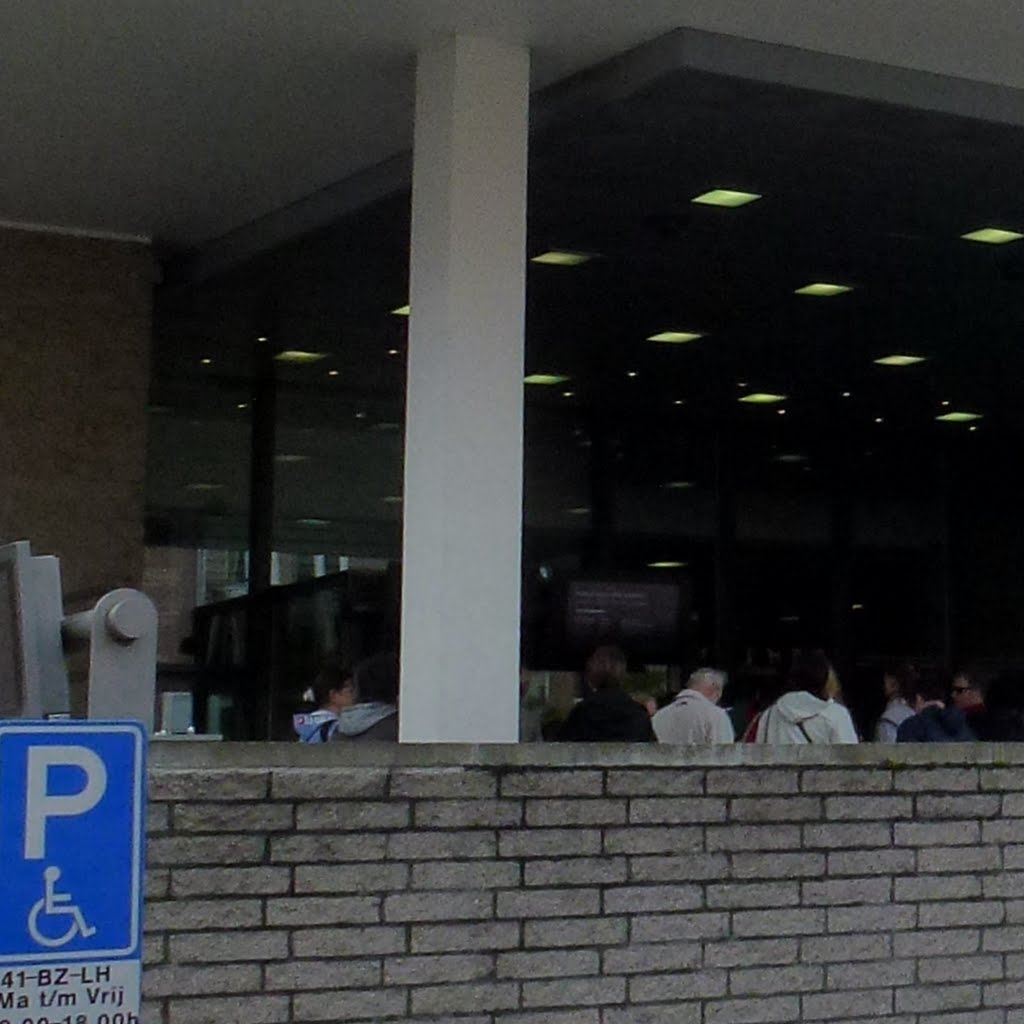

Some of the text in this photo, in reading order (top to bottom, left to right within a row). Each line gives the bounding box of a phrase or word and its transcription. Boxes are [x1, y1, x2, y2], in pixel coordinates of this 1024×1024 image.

[24, 745, 107, 860] P
[1, 965, 110, 988] 41-BZ-LH
[0, 986, 124, 1008] Ma t/m Vrij
